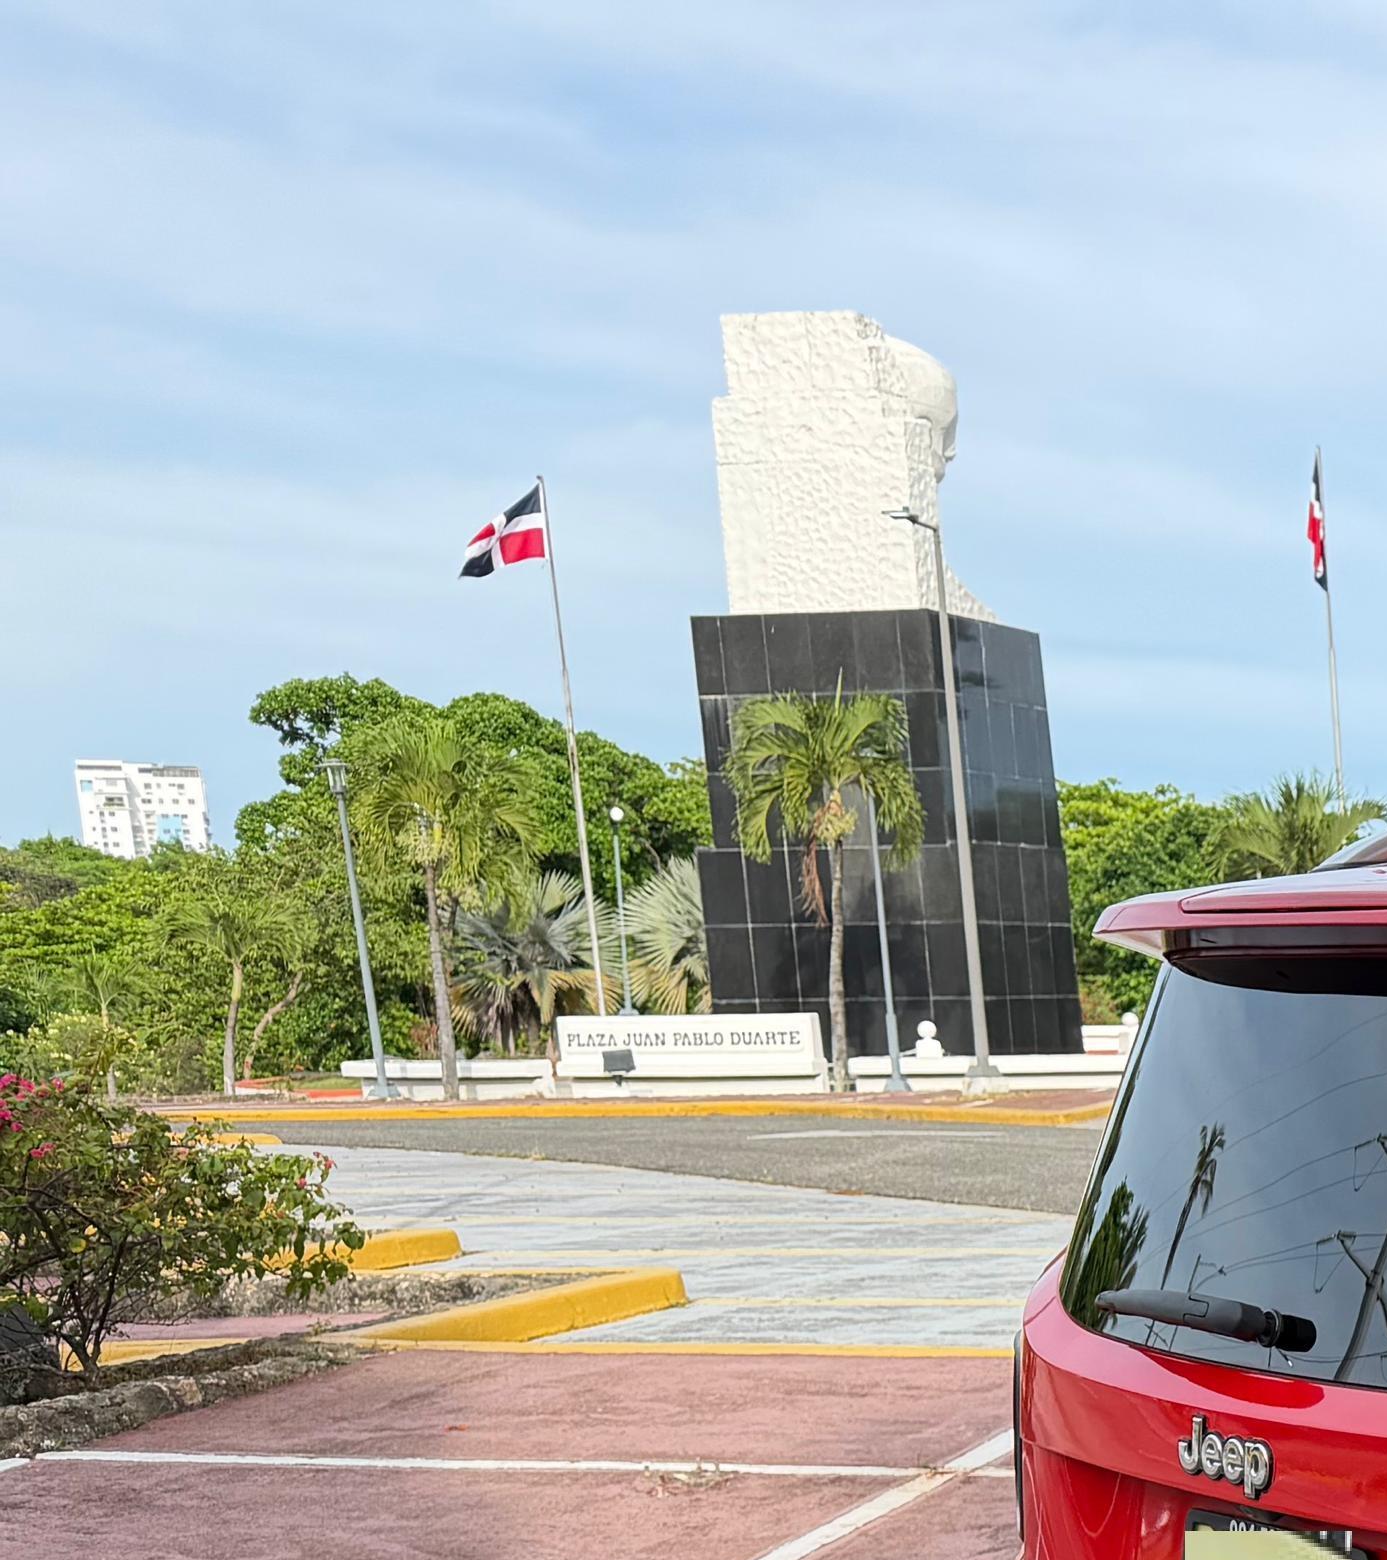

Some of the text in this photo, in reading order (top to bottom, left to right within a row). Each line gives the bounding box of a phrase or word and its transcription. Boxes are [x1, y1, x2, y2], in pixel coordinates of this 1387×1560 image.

[567, 1030, 801, 1047] PLAZA JUAN PABLO DUARTE
[1178, 1414, 1273, 1500] Jeep
